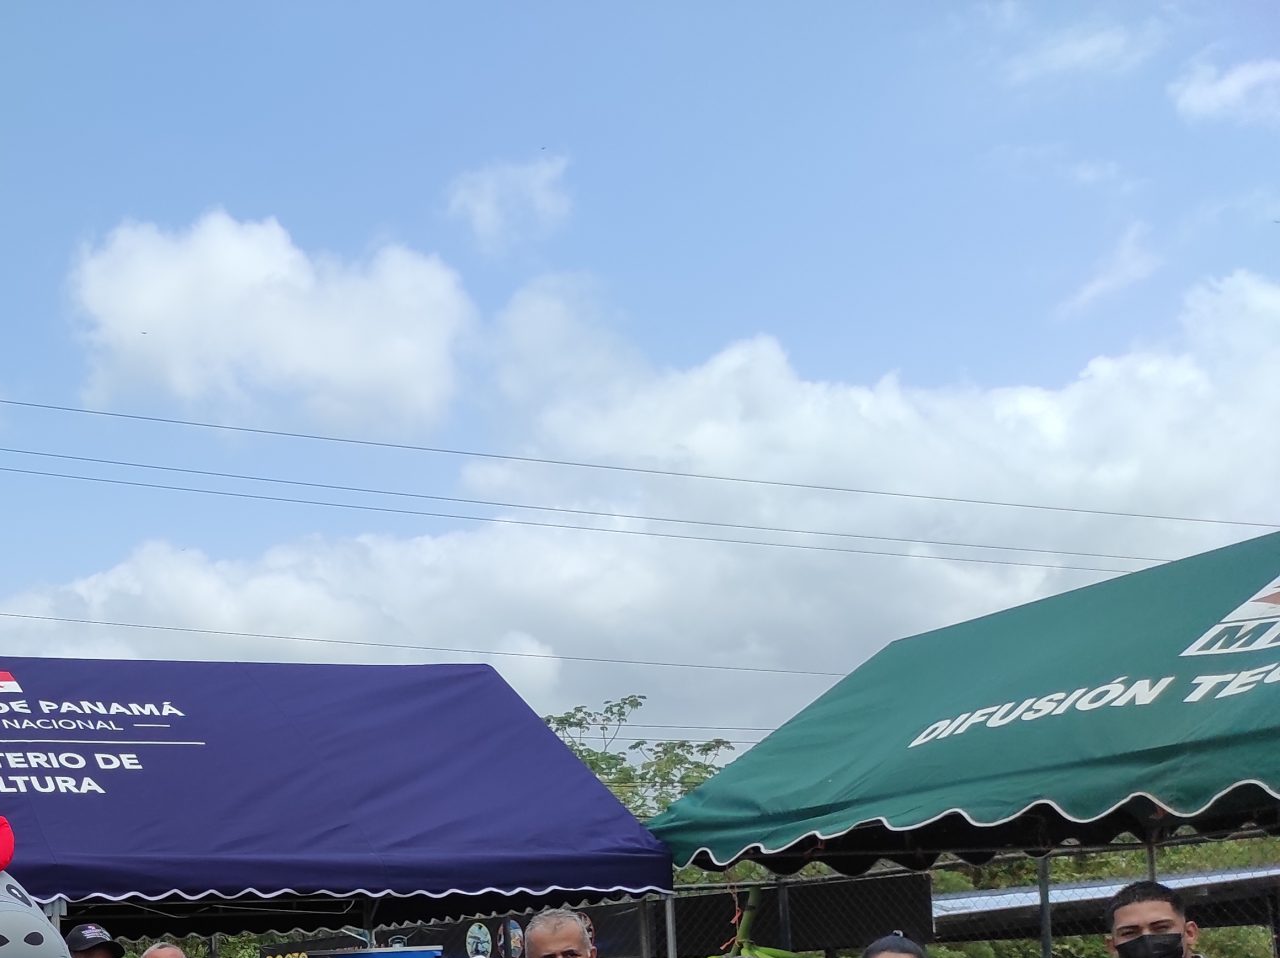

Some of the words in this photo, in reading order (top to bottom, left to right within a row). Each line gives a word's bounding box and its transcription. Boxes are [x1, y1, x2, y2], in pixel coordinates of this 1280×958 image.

[39, 700, 186, 717] PANAMÁ
[908, 676, 1175, 748] DIFUSIÓN
[1, 718, 124, 731] NACIONAL
[95, 753, 143, 770] DE
